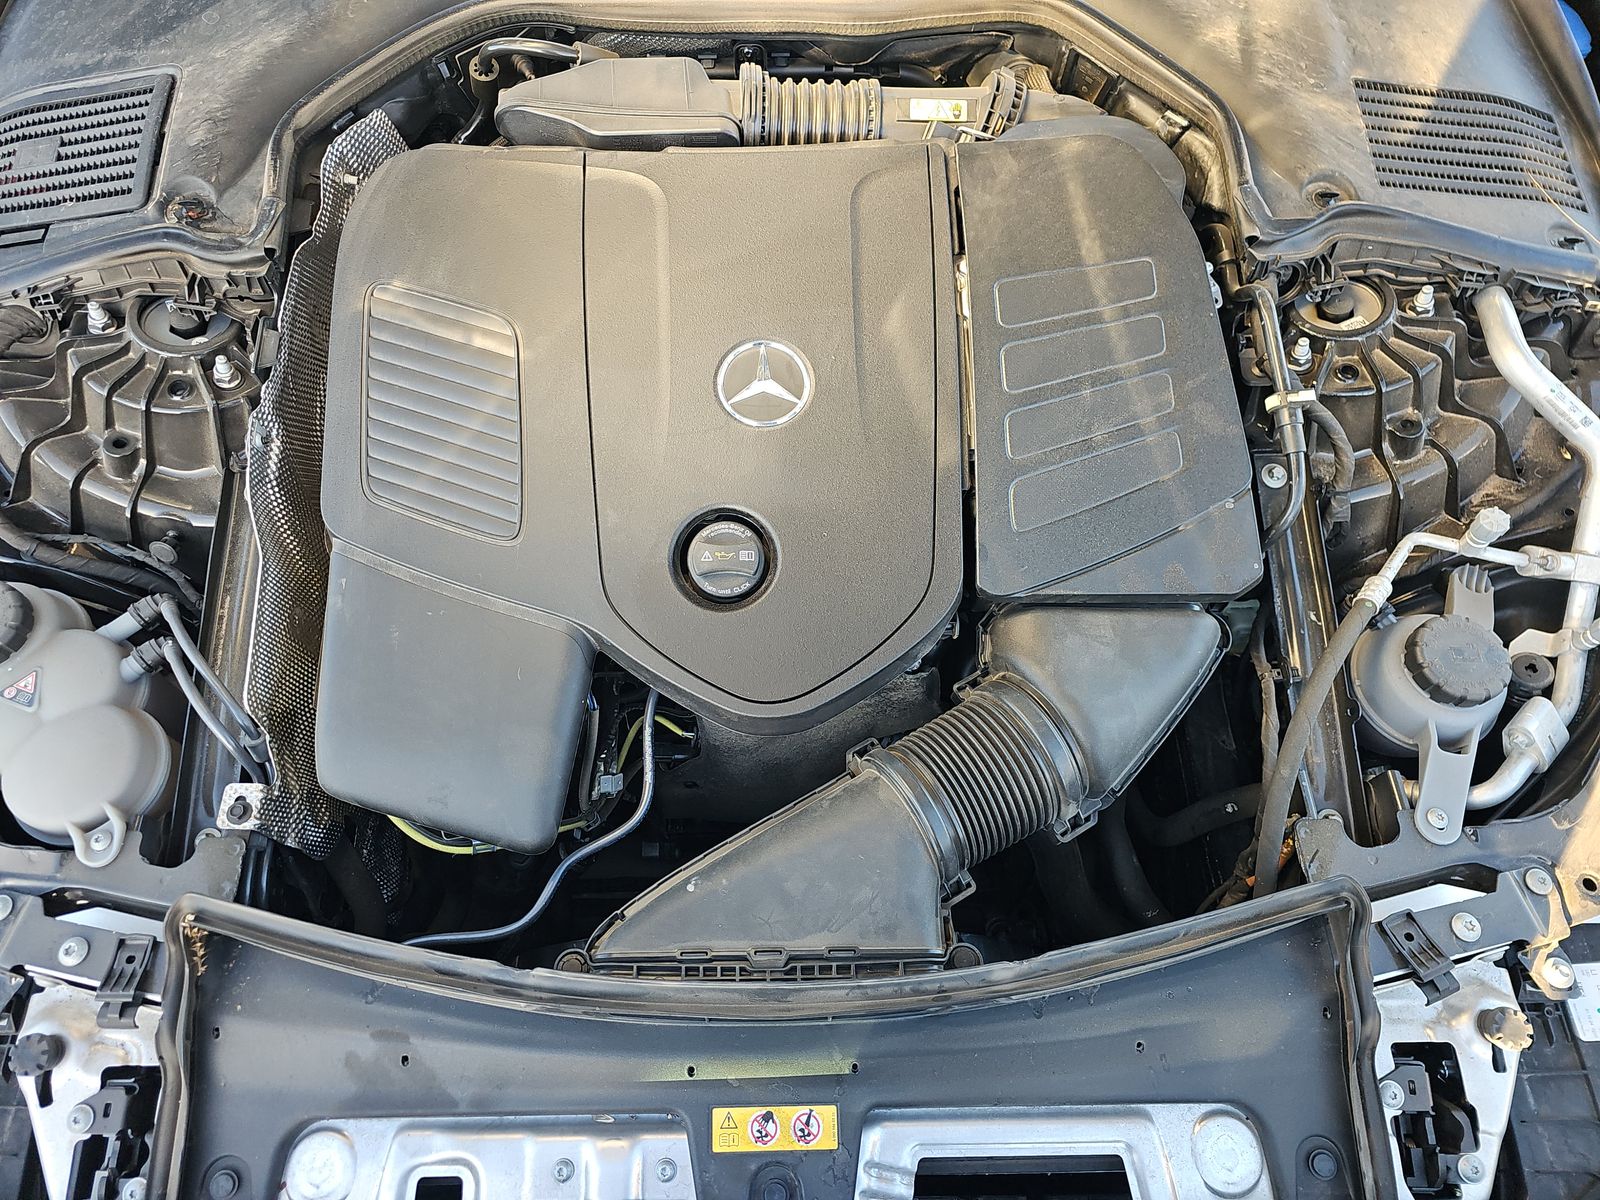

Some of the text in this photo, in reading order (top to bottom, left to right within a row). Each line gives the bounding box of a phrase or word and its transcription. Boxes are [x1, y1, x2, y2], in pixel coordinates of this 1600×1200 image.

[702, 524, 744, 537] Mercedes-Benz
[708, 529, 746, 538] recommended
[704, 582, 716, 592] Turn
[734, 581, 751, 593] CLICK
